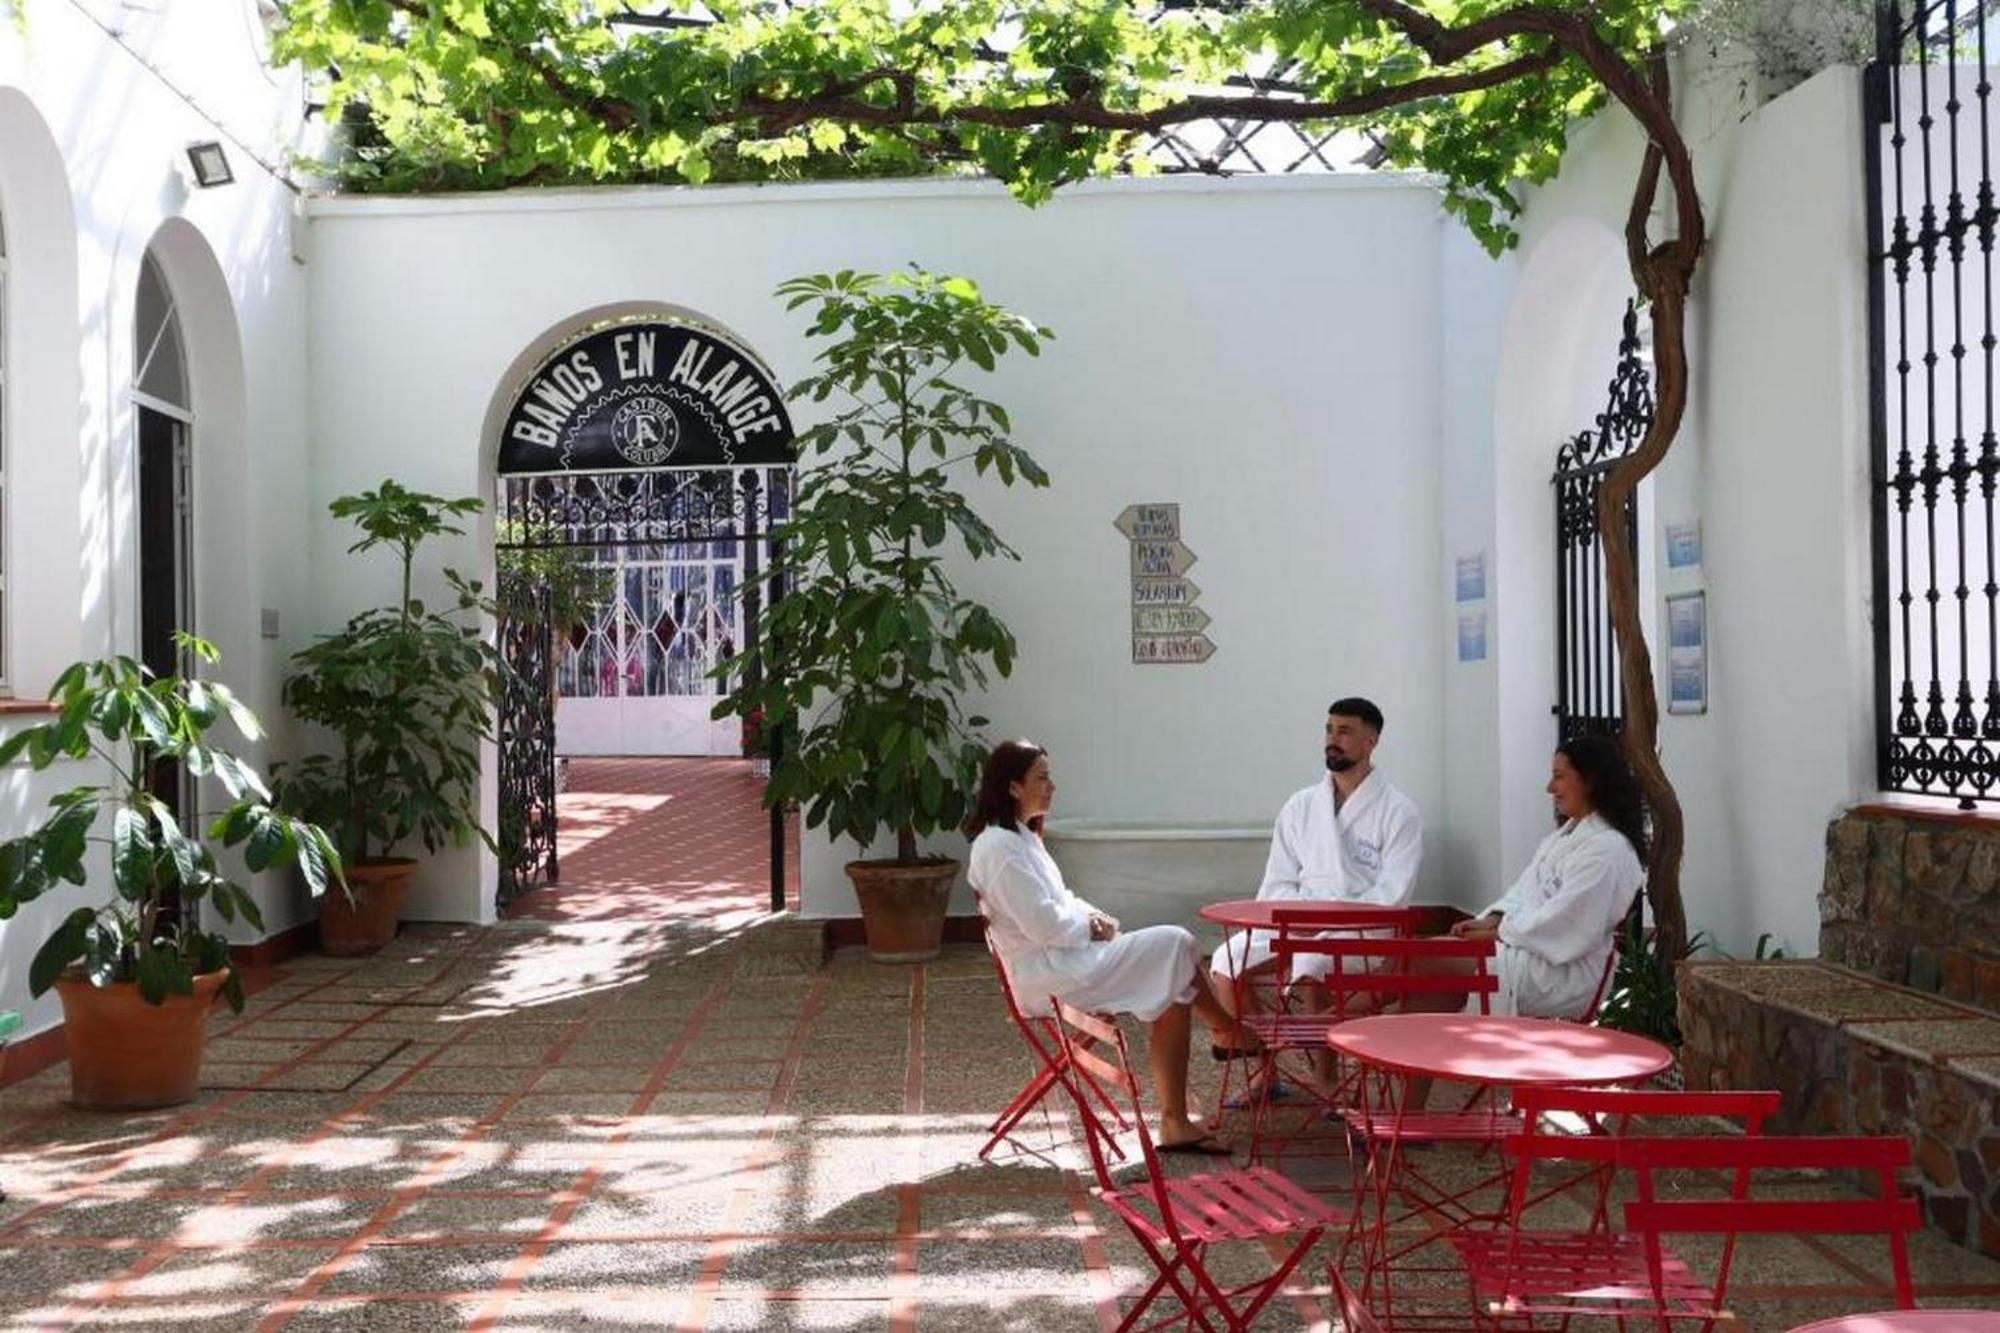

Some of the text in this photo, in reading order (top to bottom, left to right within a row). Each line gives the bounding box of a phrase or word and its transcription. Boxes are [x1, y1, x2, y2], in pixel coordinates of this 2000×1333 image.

[512, 332, 782, 449] BAÑOS EN ALANGE
